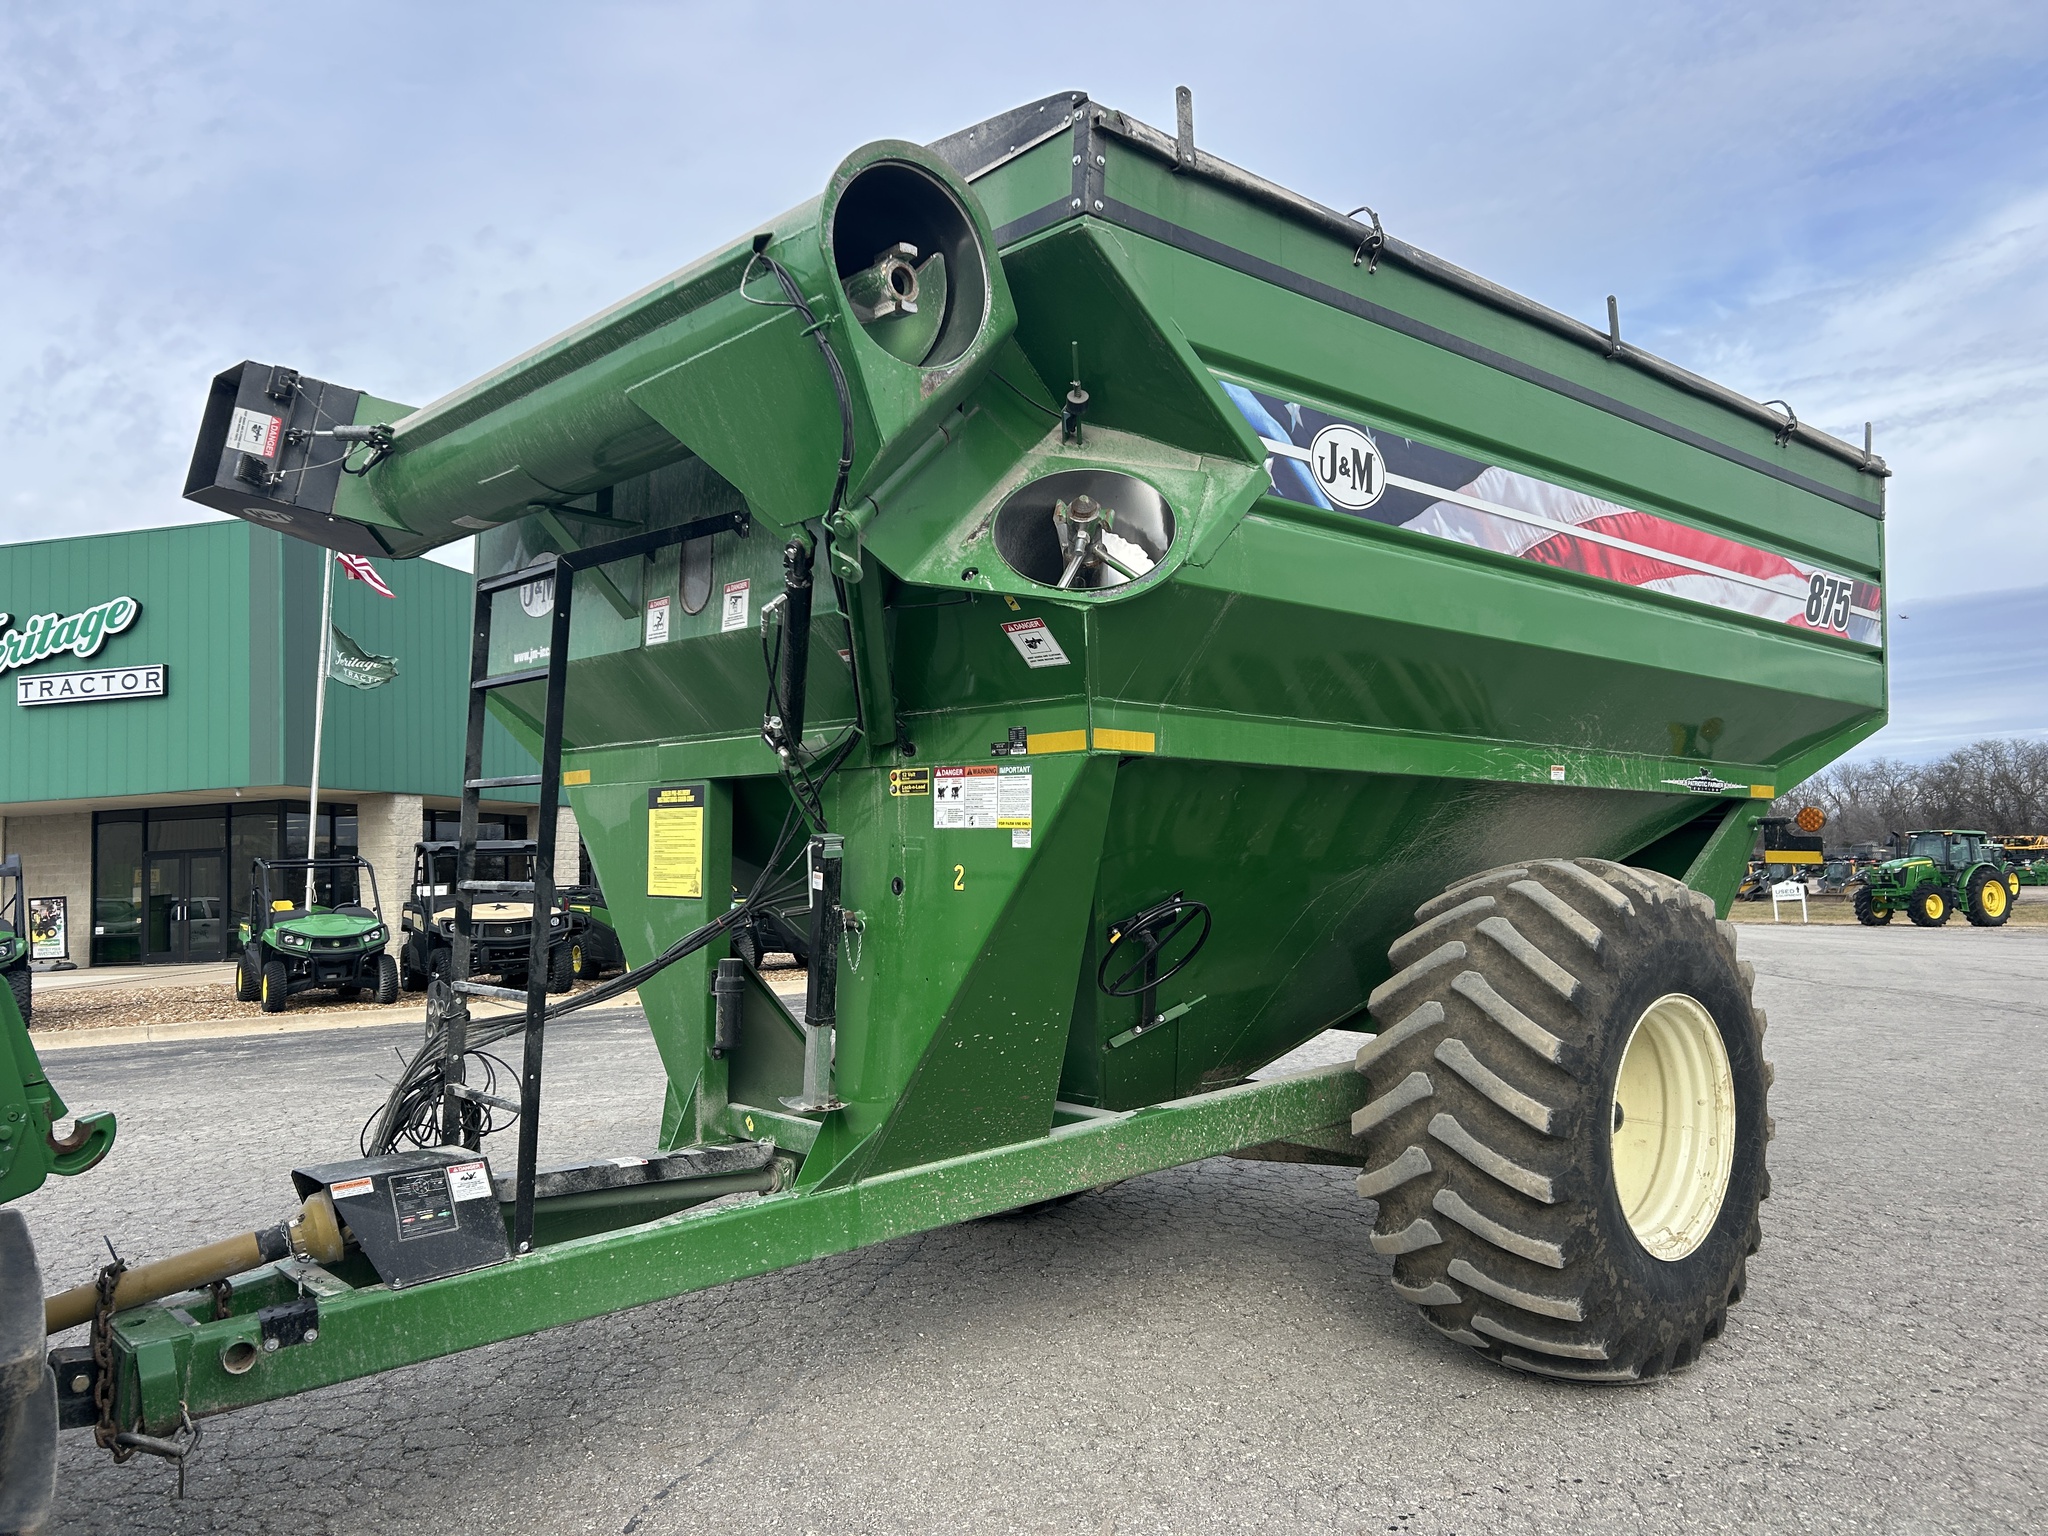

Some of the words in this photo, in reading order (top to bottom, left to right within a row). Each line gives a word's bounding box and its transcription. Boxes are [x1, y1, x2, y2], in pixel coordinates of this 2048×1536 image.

[264, 425, 279, 456] DANGER
[1318, 440, 1374, 495] J&M
[731, 582, 748, 591] DANGER
[653, 599, 668, 608] DANGER
[1805, 572, 1853, 631] 875
[1014, 620, 1041, 631] DANGER
[19, 671, 161, 699] TRACTOR
[941, 768, 963, 776] DANGER
[972, 767, 997, 775] WARNING
[999, 765, 1031, 774] IMPORTANT
[953, 864, 965, 890] 2
[458, 1164, 480, 1172] DANGER
